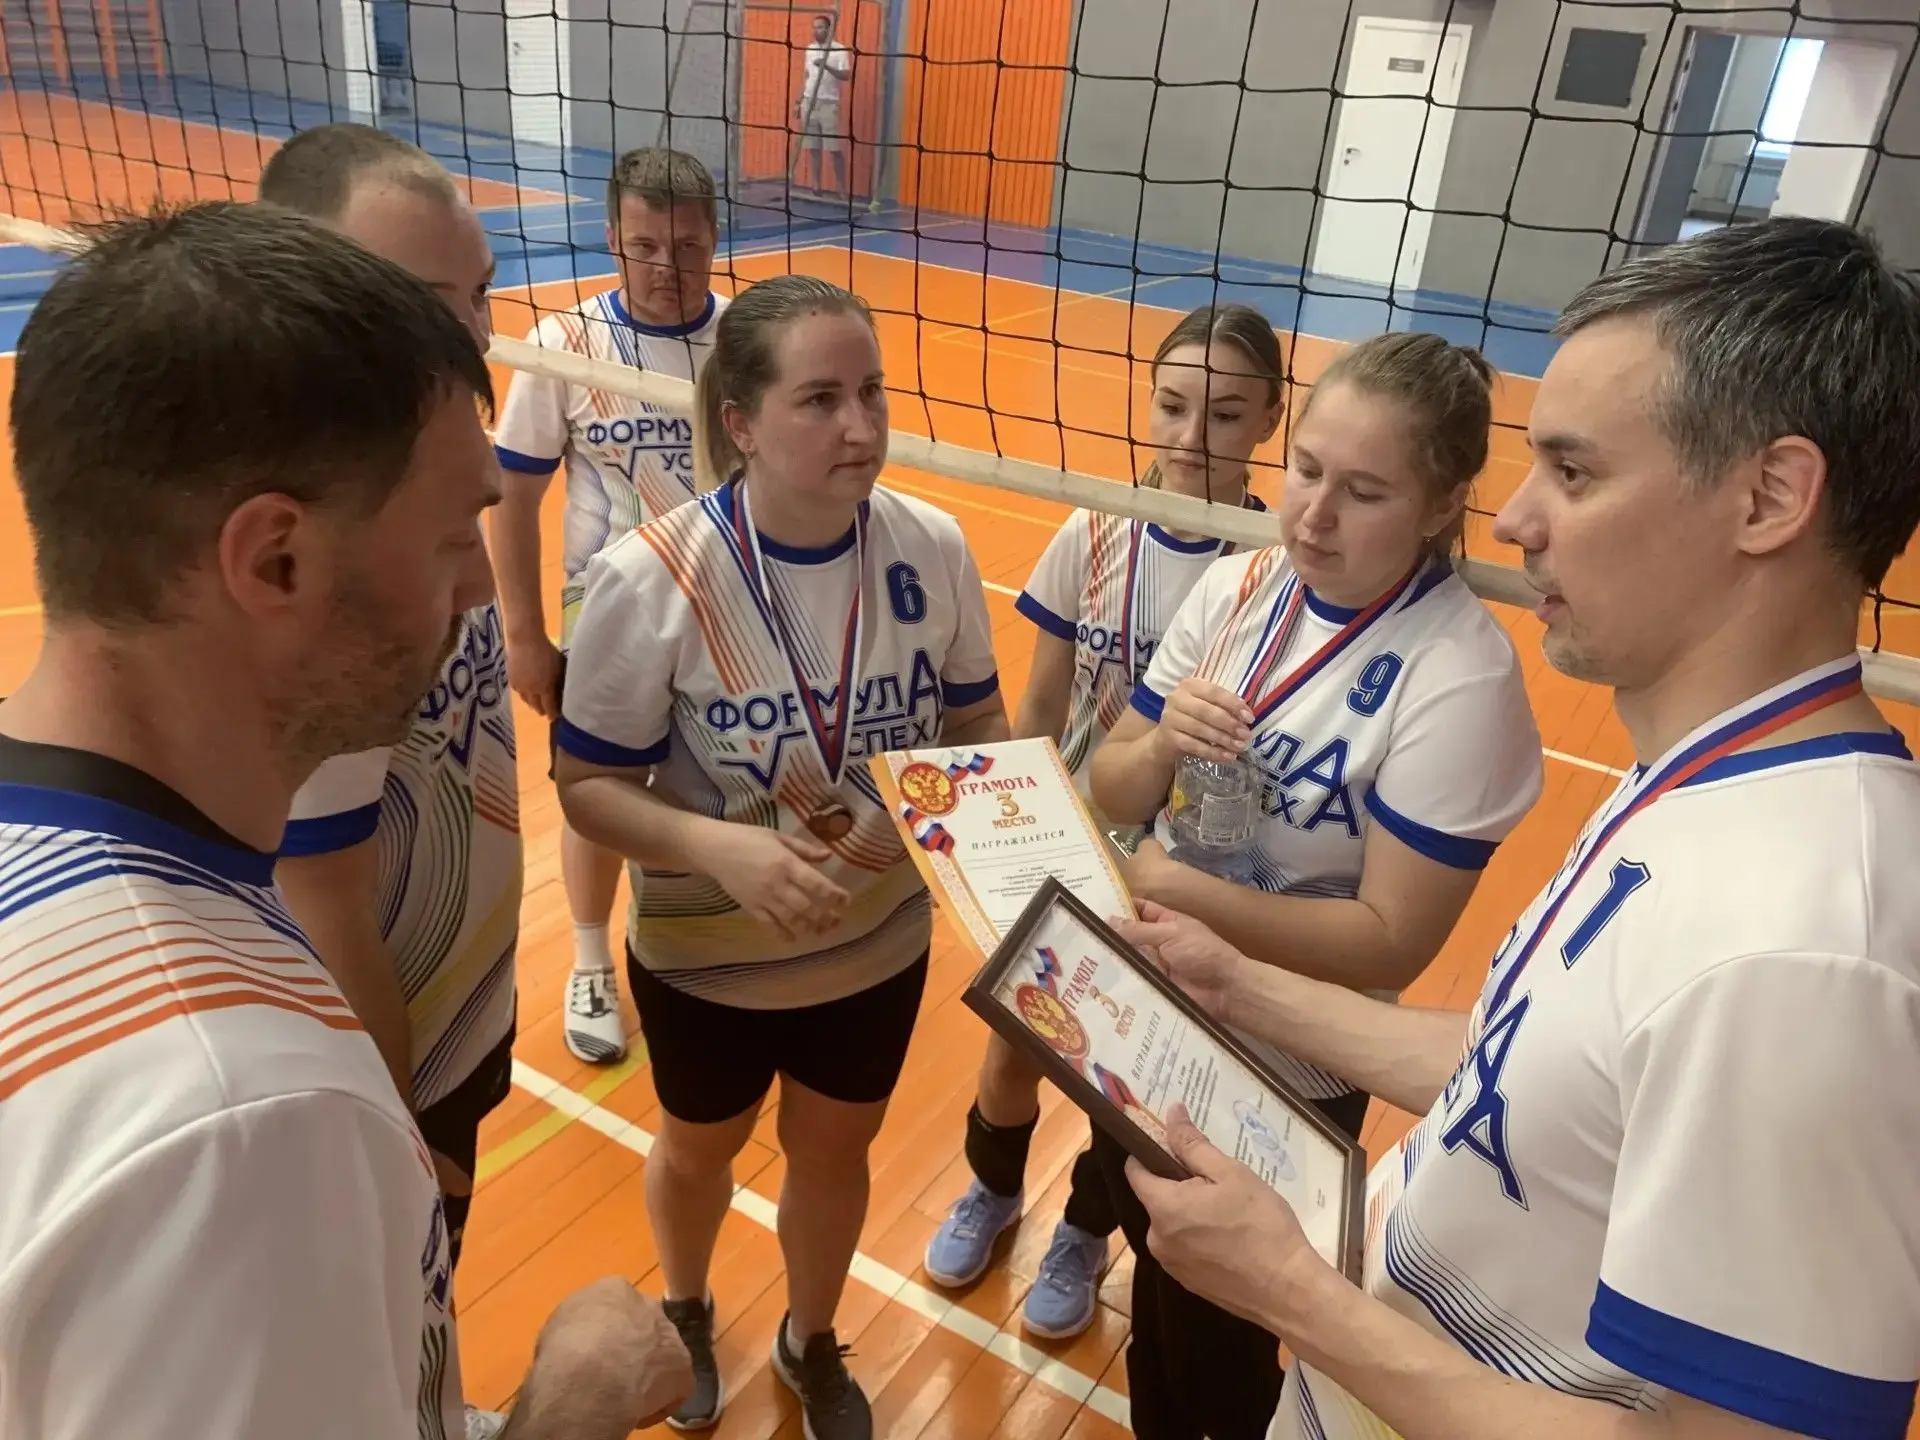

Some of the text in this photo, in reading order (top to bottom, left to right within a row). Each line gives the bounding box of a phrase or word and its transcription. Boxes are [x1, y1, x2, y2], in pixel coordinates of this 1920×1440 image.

[885, 560, 927, 625] 6
[1347, 650, 1405, 718] 9
[959, 775, 1038, 797] ГРАМОТА
[996, 791, 1020, 817] 3
[971, 829, 1066, 850] НАГРАЖДАЕТСЯ
[991, 815, 1038, 830] МЕСТО
[1560, 856, 1652, 971] 1
[1060, 954, 1100, 1012] ГРАМОТА
[1088, 984, 1120, 1019] 3
[1114, 1003, 1137, 1041] МЕСТО
